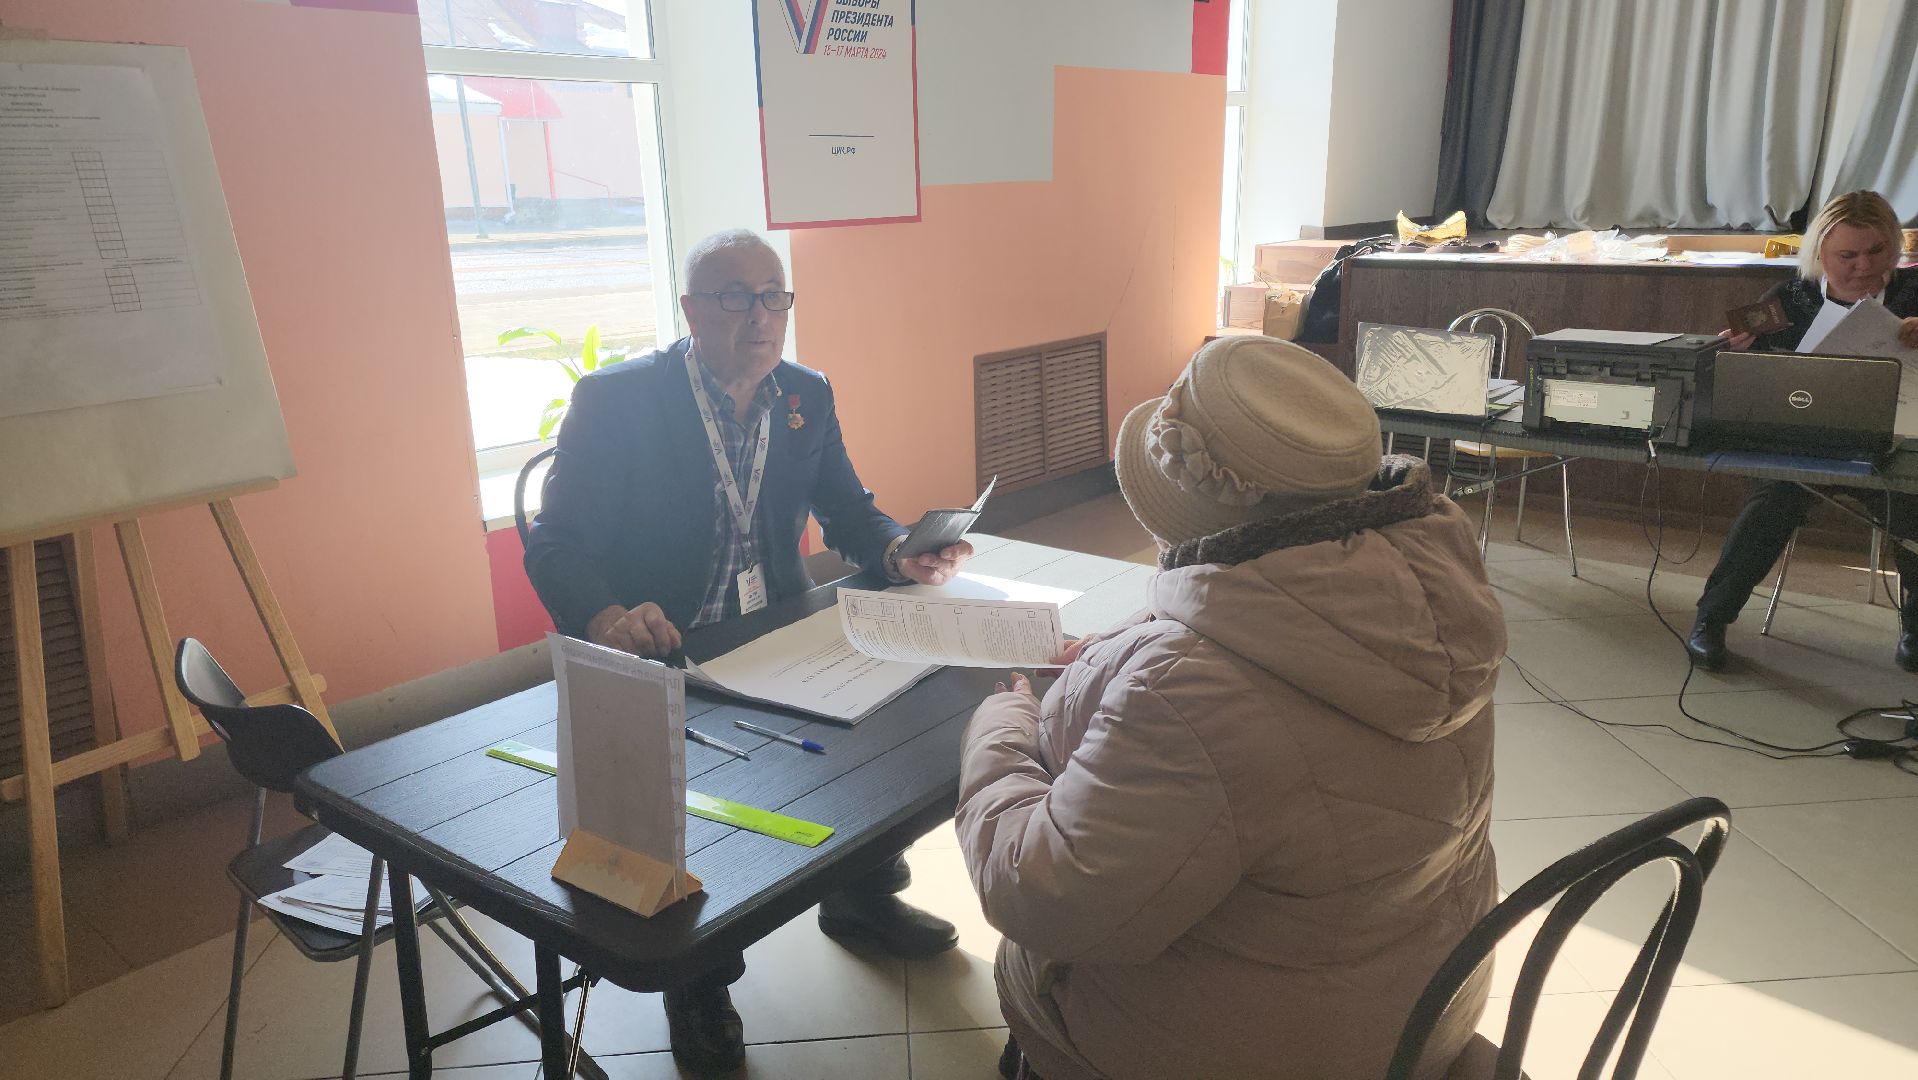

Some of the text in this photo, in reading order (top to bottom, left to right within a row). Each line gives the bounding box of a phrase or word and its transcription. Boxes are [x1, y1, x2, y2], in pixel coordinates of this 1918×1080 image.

[831, 10, 894, 28] ПРЕЗИДЕНТА
[827, 28, 869, 43] РОССИИ
[844, 46, 869, 59] МАРТА
[831, 146, 856, 156] ЦИК.РФ
